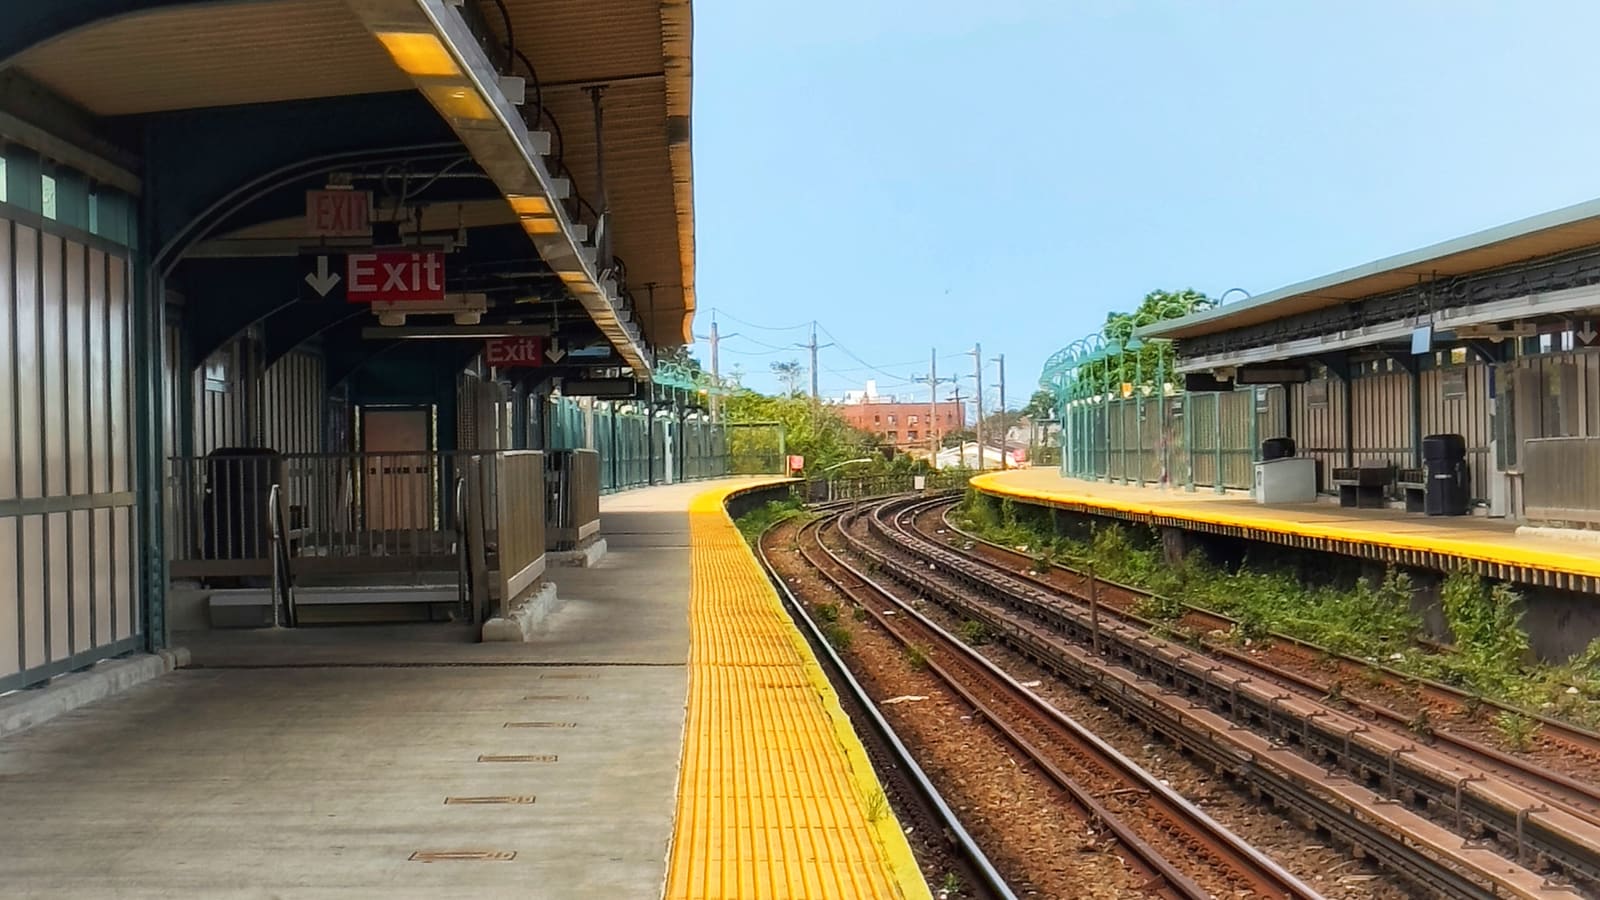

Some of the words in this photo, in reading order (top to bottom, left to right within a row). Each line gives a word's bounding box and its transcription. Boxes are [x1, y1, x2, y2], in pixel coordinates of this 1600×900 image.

[317, 194, 367, 230] EXIT
[348, 253, 441, 292] Exit
[486, 339, 536, 361] Exit
